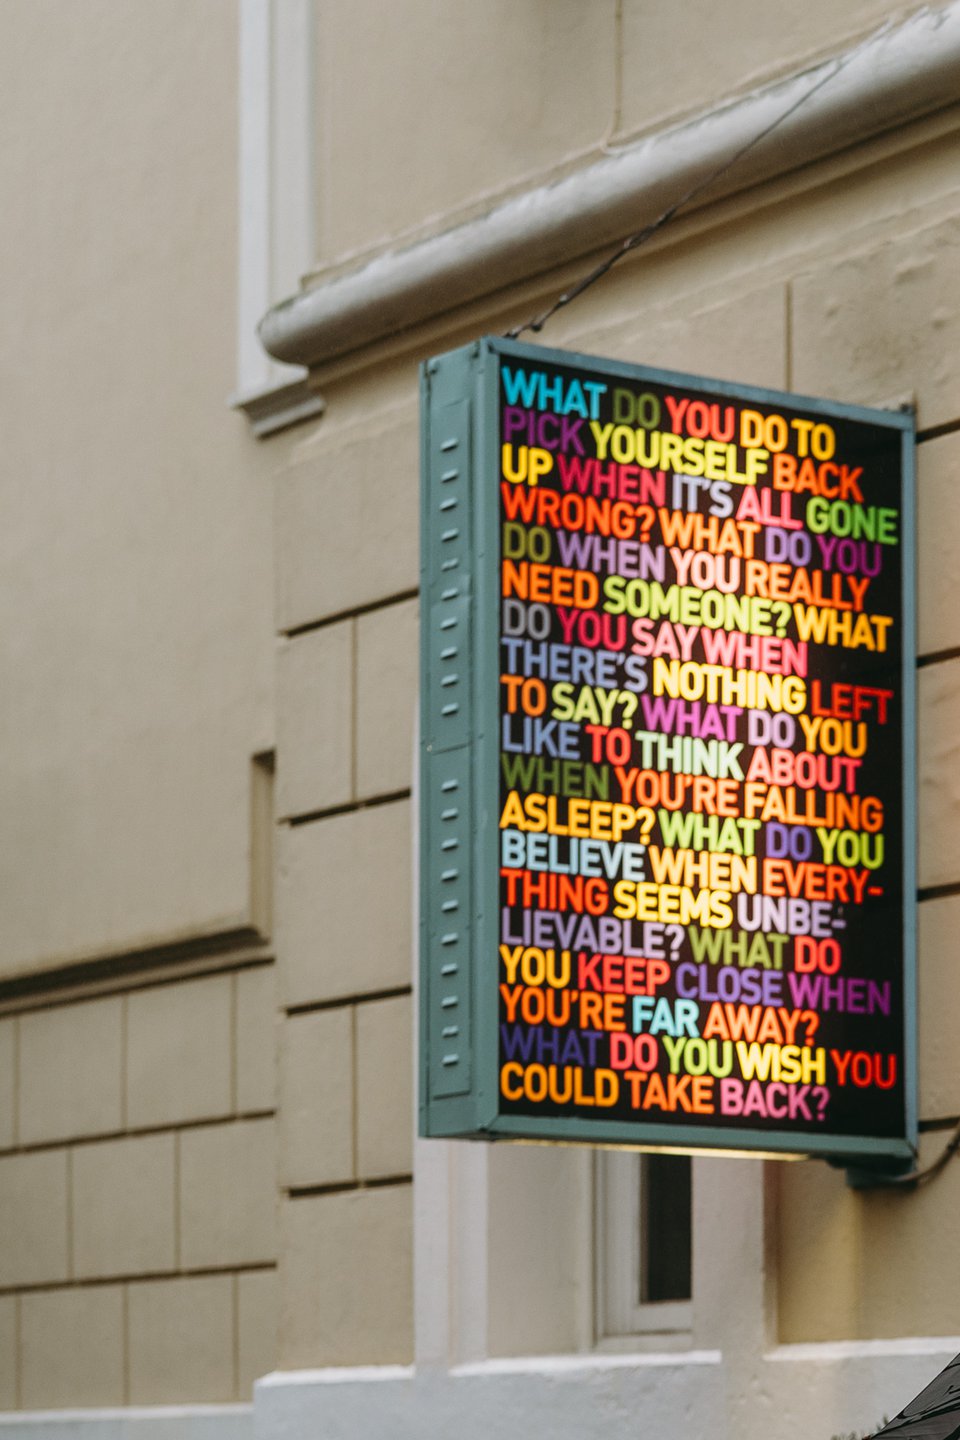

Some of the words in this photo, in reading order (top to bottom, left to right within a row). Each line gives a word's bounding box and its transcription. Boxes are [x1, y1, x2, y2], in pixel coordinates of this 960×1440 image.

[501, 366, 607, 420] WHAT
[613, 388, 660, 427] DO
[666, 396, 734, 442] YOU
[740, 410, 787, 452] DO
[792, 419, 835, 460] TO
[502, 444, 553, 486] UP
[556, 455, 666, 506] WHEN
[672, 474, 733, 518] IT'S
[736, 487, 801, 529] ALL
[806, 497, 898, 544] GONE
[503, 407, 584, 456] PICK
[589, 420, 769, 485] YOURSELF
[773, 454, 864, 502] BACK
[502, 483, 656, 544] WRONG?
[658, 508, 761, 558] WHAT
[765, 527, 811, 566] DO
[815, 538, 882, 577] YOU
[503, 522, 551, 562] DO
[556, 531, 666, 582] WHEN
[669, 548, 740, 593] YOU
[745, 561, 870, 612] REALLY
[502, 561, 598, 608] NEED
[603, 576, 791, 639] SOMEONE?
[793, 603, 893, 652] WHAT
[503, 601, 551, 640] DO
[556, 608, 627, 650] YOU
[632, 620, 700, 658] SAY
[701, 629, 808, 678] WHEN
[501, 674, 546, 716] TO
[551, 683, 638, 729] SAY?
[641, 695, 743, 741] WHAT
[748, 709, 796, 748] DO
[800, 715, 867, 757] YOU
[502, 638, 647, 693] THERE'S
[652, 658, 807, 714] NOTHING
[811, 680, 893, 724] LEFT
[501, 754, 609, 801] WHEN
[615, 766, 739, 817] YOU'RE
[744, 783, 883, 833] FALLING
[502, 715, 581, 759] LIKE
[586, 724, 631, 766] TO
[635, 732, 745, 781] THINK
[746, 748, 862, 794] ABOUT
[500, 791, 655, 842] ASLEEP?
[658, 809, 761, 856] WHAT
[766, 823, 812, 861] DO
[816, 827, 883, 869] YOU
[502, 831, 646, 881] BELIEVE
[648, 846, 757, 895] WHEN
[763, 859, 883, 904] EVERY-
[501, 868, 608, 915] THING
[613, 882, 733, 929] SEEMS
[737, 892, 846, 936] UNBE-
[502, 908, 684, 961] LIEVABLE?
[688, 927, 789, 970] WHAT
[794, 936, 841, 974] DO
[500, 945, 570, 988] YOU
[578, 954, 670, 997] KEEP
[675, 964, 783, 1007] CLOSE
[787, 972, 891, 1015] WHEN
[500, 984, 626, 1032] YOU'RE
[632, 996, 700, 1038] FAR
[703, 1003, 819, 1044] AWAY?
[501, 1023, 603, 1066] WHAT
[610, 1033, 658, 1072] DO
[662, 1036, 732, 1078] YOU
[736, 1041, 826, 1086] WISH
[830, 1049, 897, 1089] YOU
[501, 1062, 619, 1107] COULD
[624, 1070, 715, 1115] TAKE
[720, 1079, 829, 1121] BACK?
